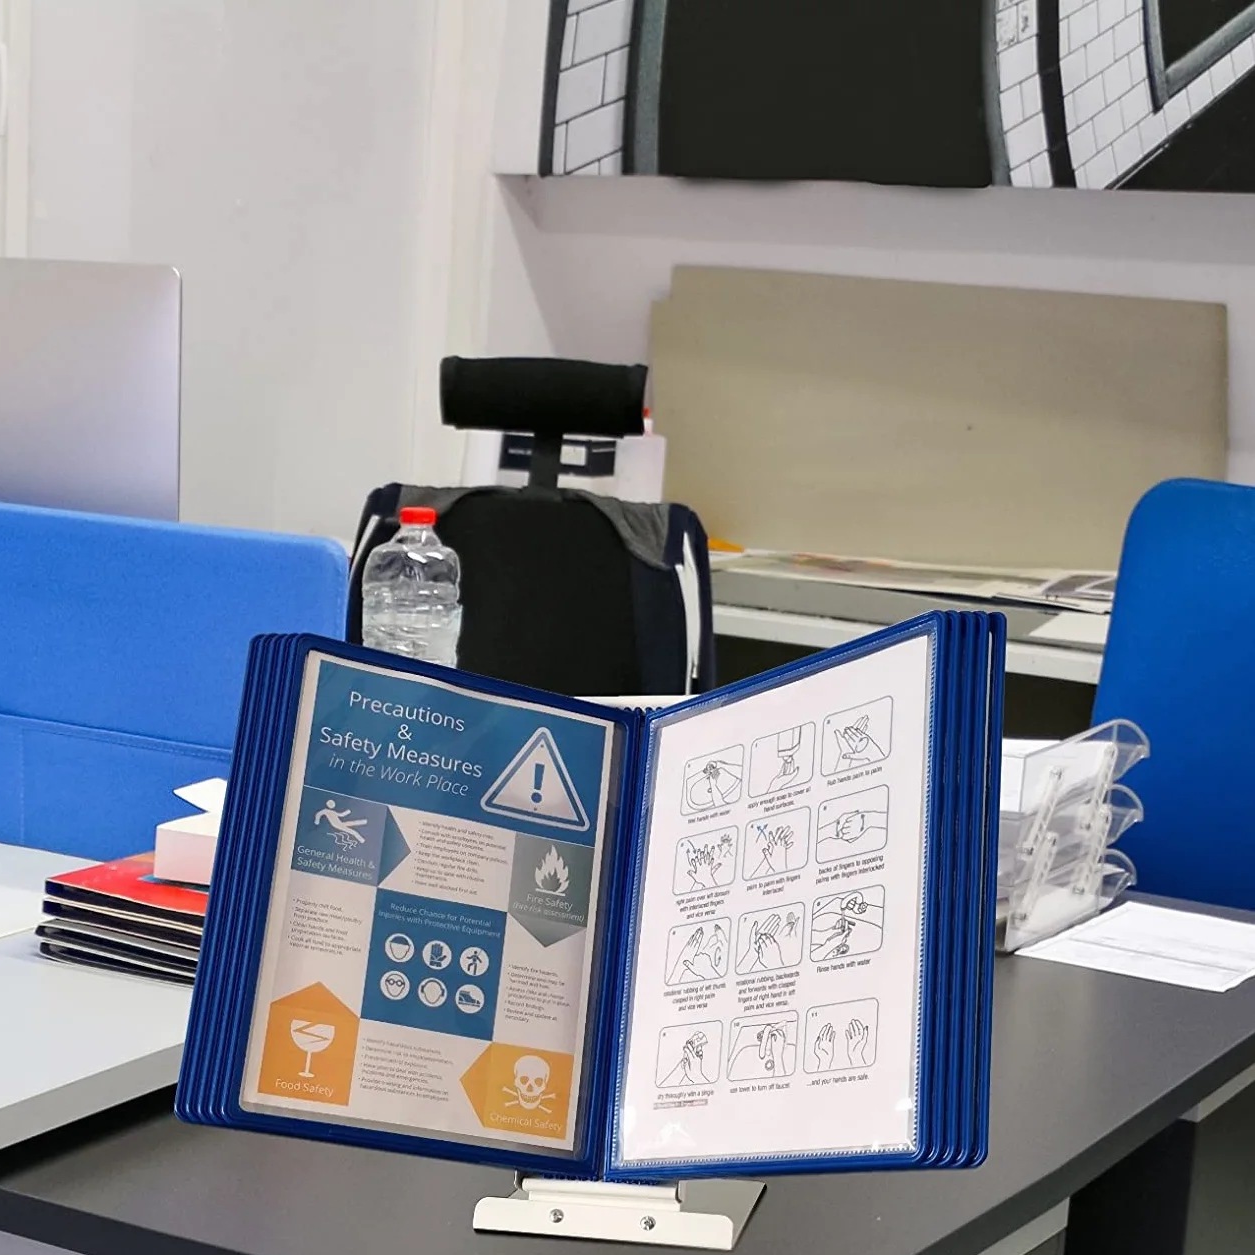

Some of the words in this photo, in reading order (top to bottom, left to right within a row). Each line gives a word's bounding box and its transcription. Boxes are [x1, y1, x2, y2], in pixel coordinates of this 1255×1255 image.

[349, 691, 465, 732] Precautions
[397, 724, 412, 741] &
[320, 726, 382, 759] Safety
[387, 742, 482, 778] Measures
[329, 753, 345, 770] in
[350, 759, 376, 778] the
[381, 765, 423, 787] Work
[426, 774, 469, 796] Place
[297, 845, 334, 861] General
[336, 851, 366, 868] Health
[368, 861, 375, 869] &
[297, 857, 326, 871] Safety
[328, 864, 372, 880] Measures
[527, 894, 543, 904] Fire
[545, 896, 573, 910] Safety
[390, 903, 417, 914] Reduce
[419, 908, 446, 920] Chance
[447, 913, 457, 921] for
[459, 916, 492, 927] Potential
[275, 1078, 301, 1091] Food
[303, 1083, 334, 1098] Safety
[490, 1112, 531, 1127] Chemical
[534, 1118, 562, 1133] Safety
